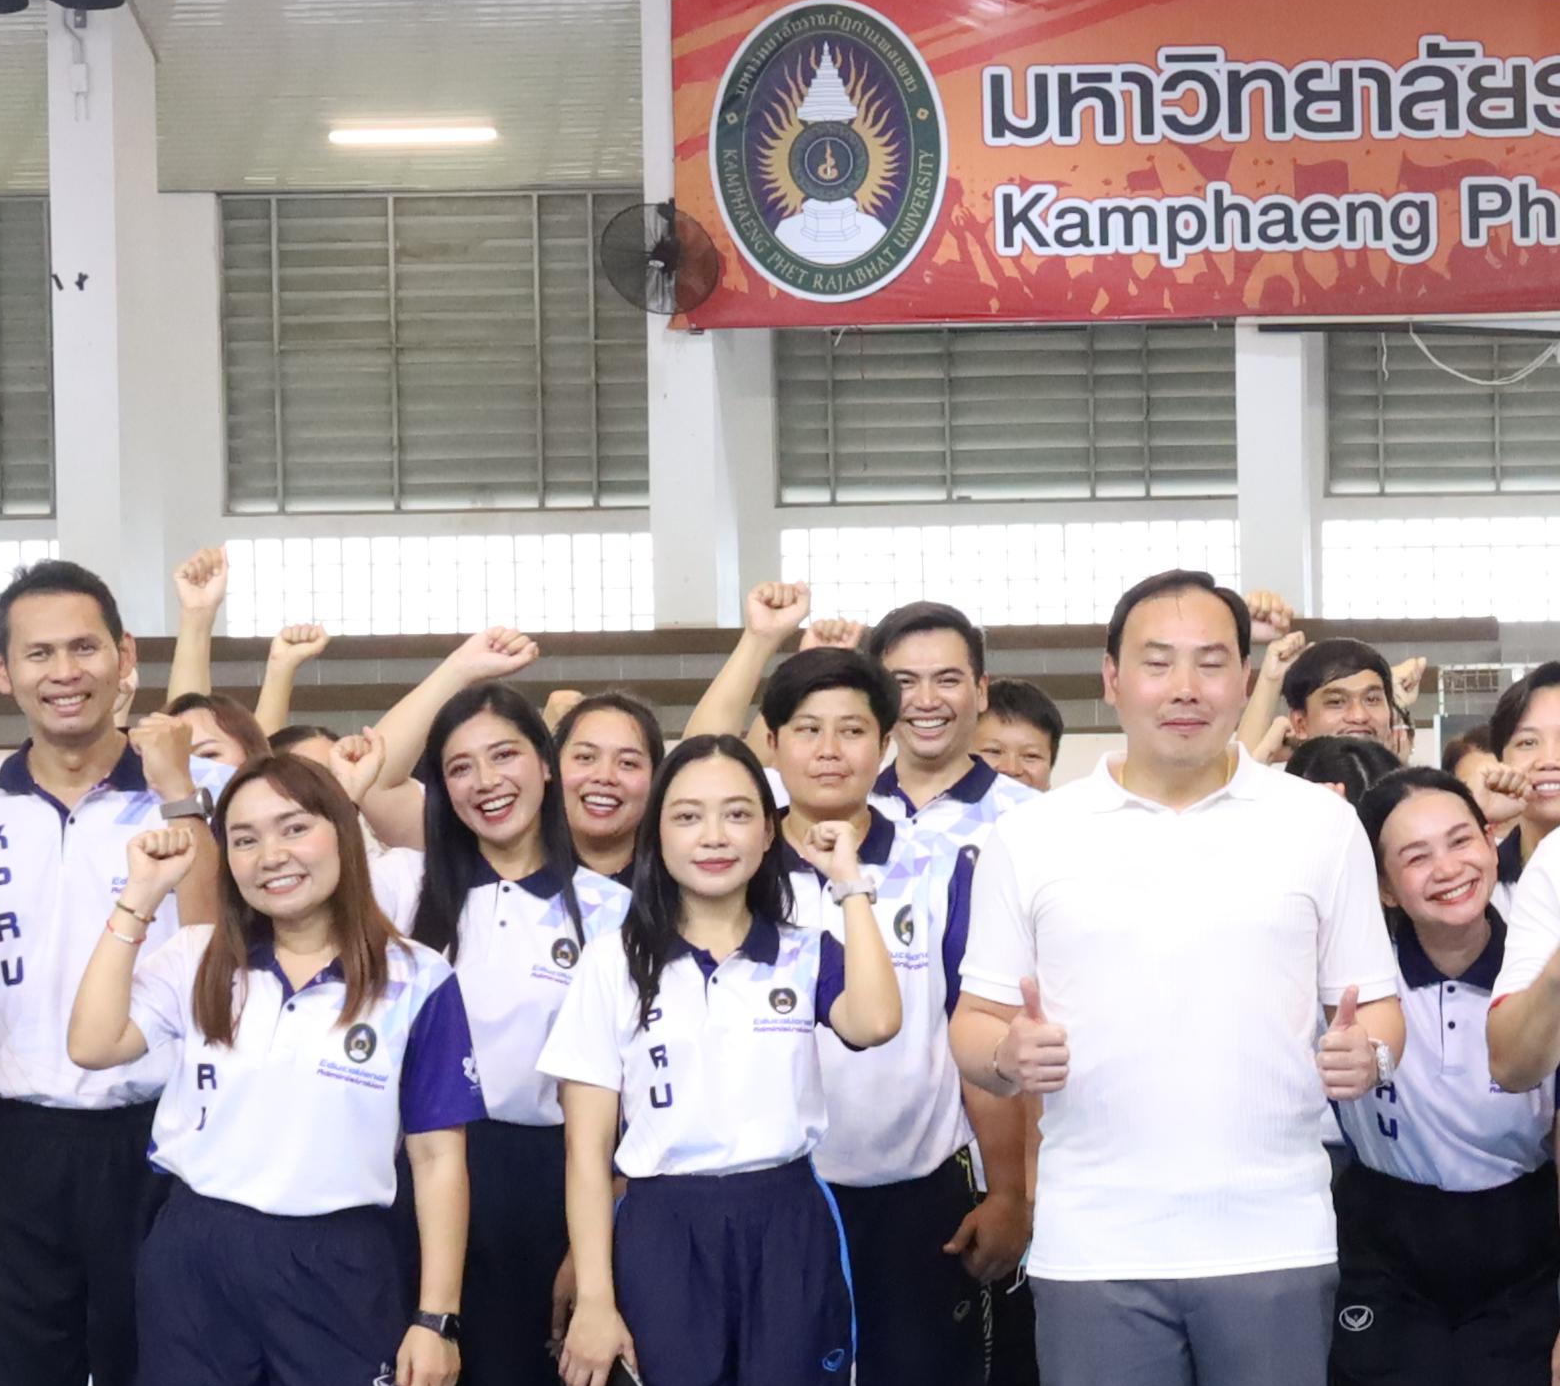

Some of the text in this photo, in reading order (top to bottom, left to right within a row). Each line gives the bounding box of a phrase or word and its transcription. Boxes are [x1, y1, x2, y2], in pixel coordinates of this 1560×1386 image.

[722, 148, 935, 293] KAMPHAENG PHET RAJABHAT UNIVERSITY
[1001, 189, 1431, 261] Kamphaeng
[644, 1008, 673, 1109] PRU
